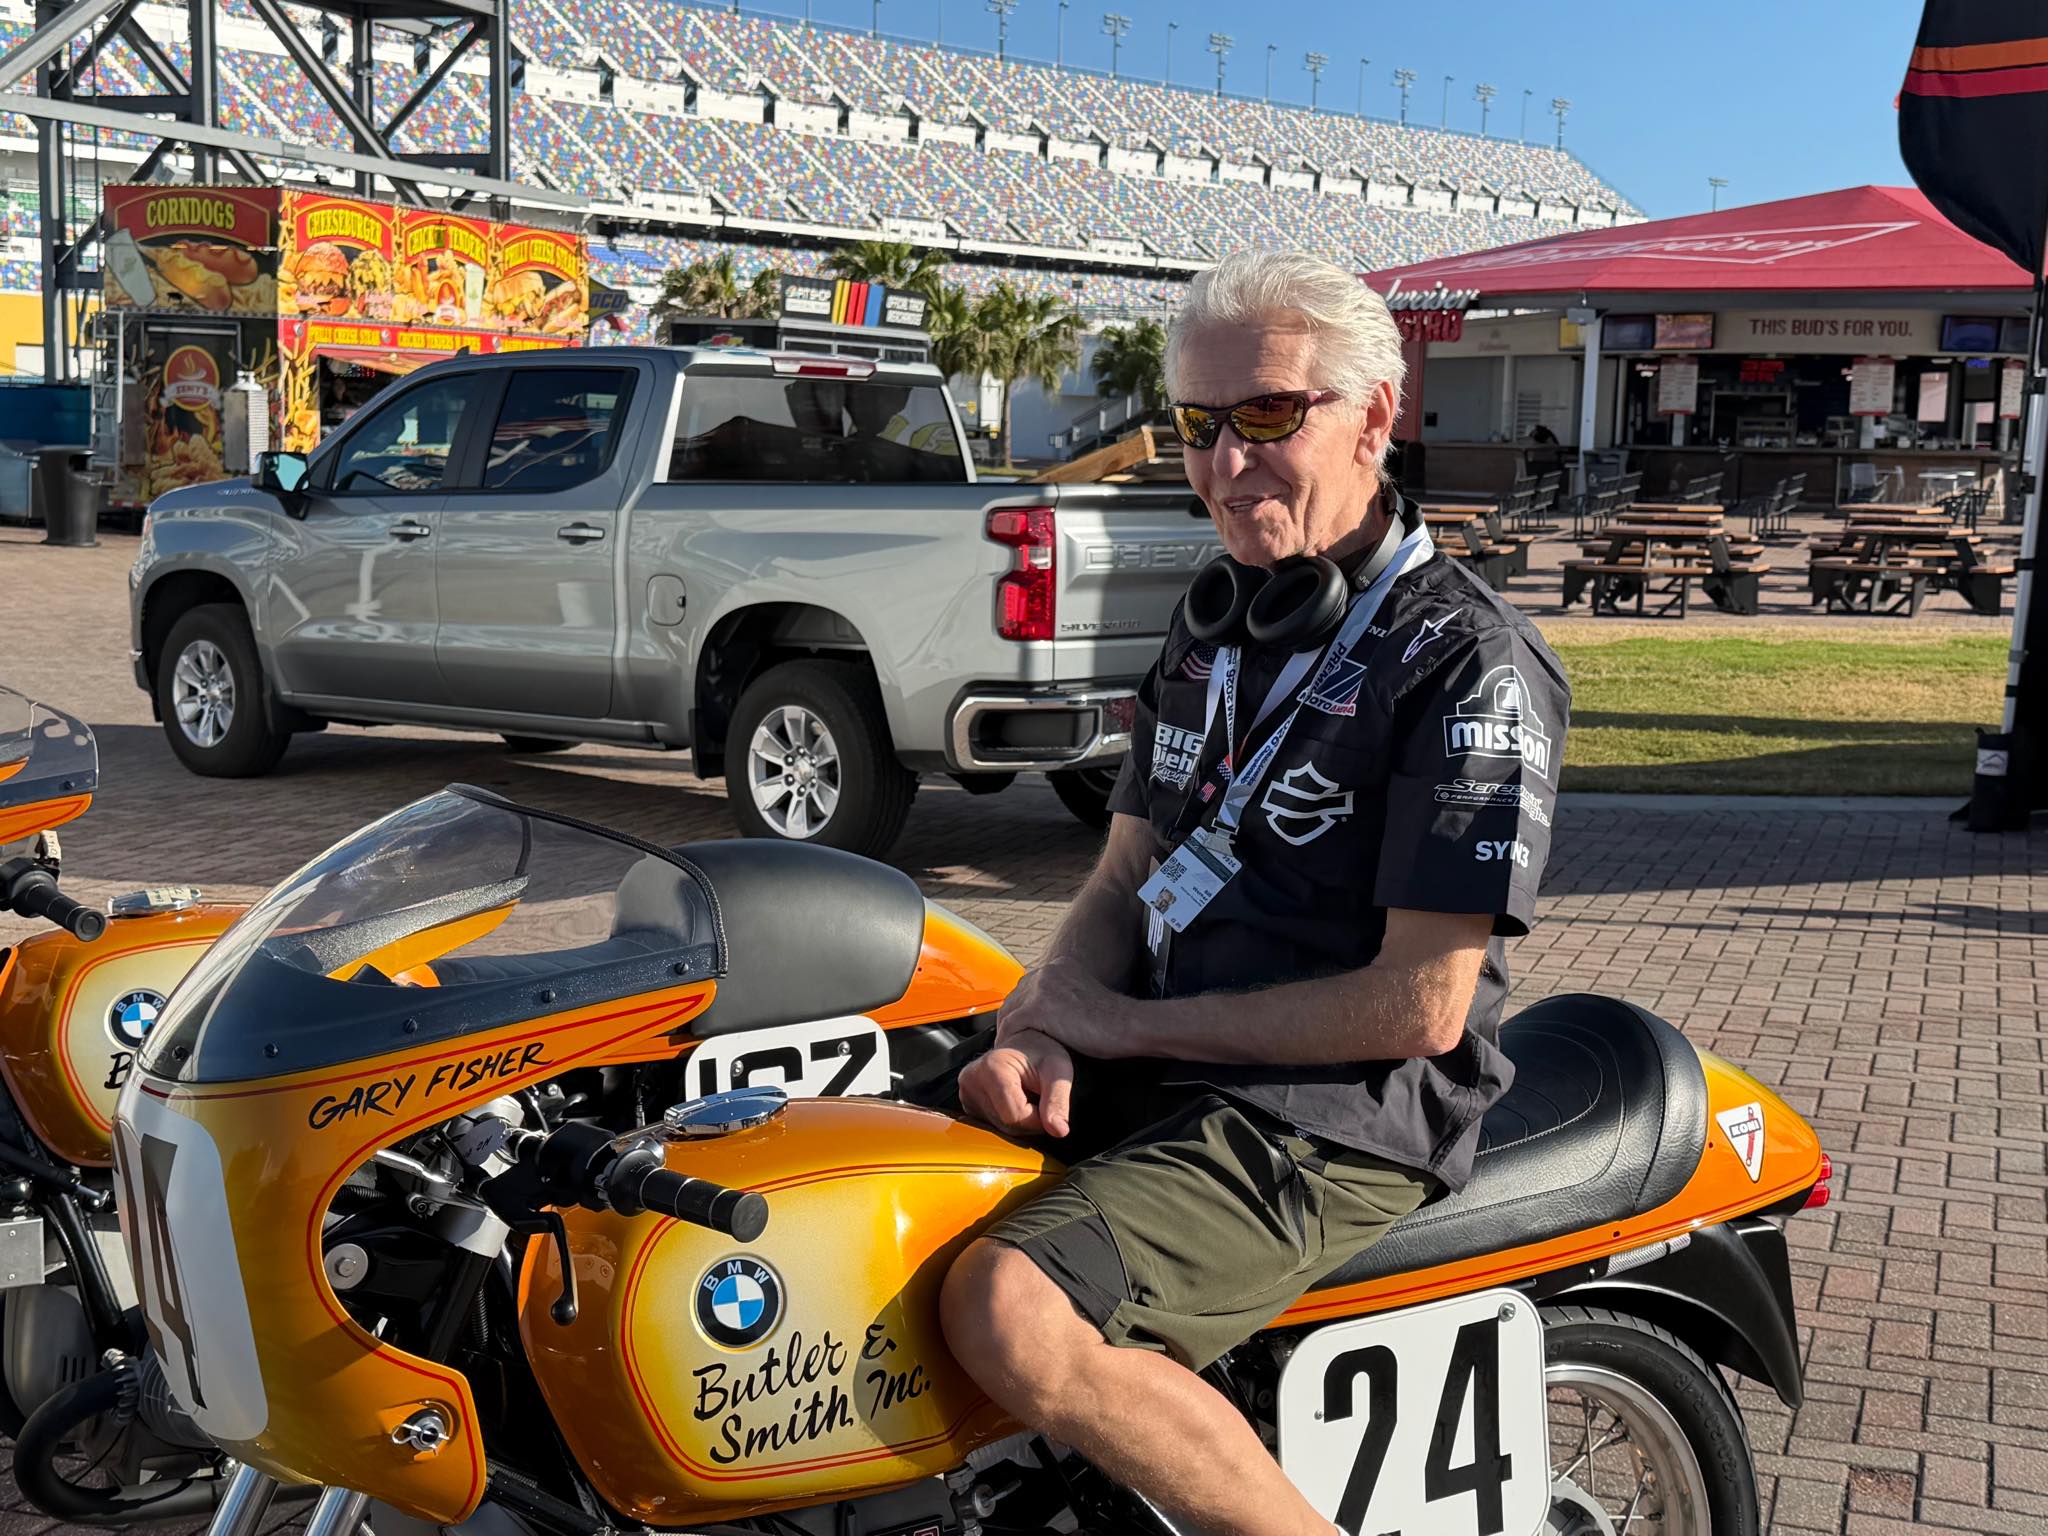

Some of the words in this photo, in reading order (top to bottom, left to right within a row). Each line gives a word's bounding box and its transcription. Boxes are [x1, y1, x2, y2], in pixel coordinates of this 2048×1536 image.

[146, 197, 236, 230] CORNDOGS
[306, 209, 383, 249] CHEESEBURGER
[1748, 318, 1787, 335] THIS
[1791, 319, 1839, 336] BUD'S
[1843, 319, 1874, 336] FOR
[1877, 320, 1913, 337] YOU.
[1312, 641, 1347, 691] PREMI
[1155, 724, 1204, 755] BIG
[1451, 721, 1546, 770] misson
[1475, 840, 1530, 868] SYN3
[115, 993, 165, 1013] BMW
[308, 1073, 416, 1130] GARY
[425, 1042, 554, 1097] FISHER
[1731, 1119, 1760, 1138] KONI
[703, 1260, 770, 1291] BMW
[692, 1331, 847, 1421] Butler
[862, 1323, 897, 1360] &
[709, 1385, 854, 1464] Smith
[866, 1364, 931, 1421] Inc.
[1324, 1315, 1513, 1536] 24
